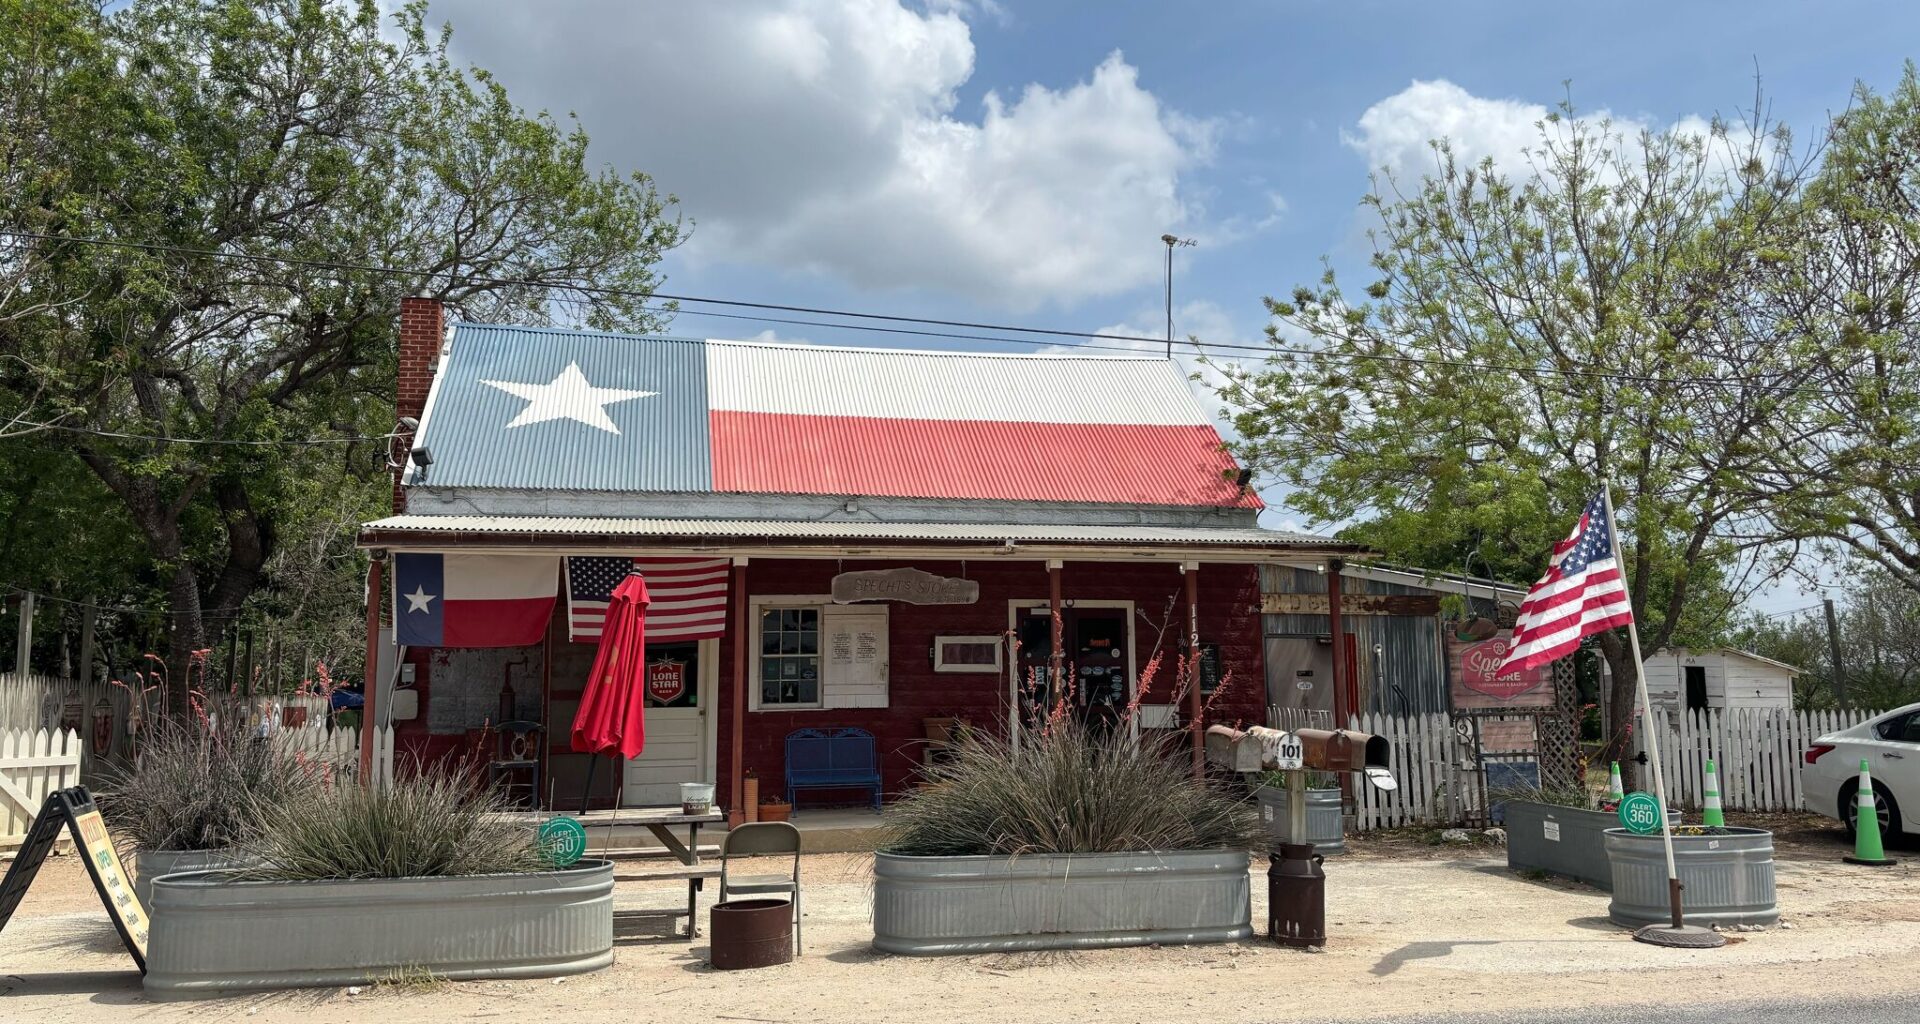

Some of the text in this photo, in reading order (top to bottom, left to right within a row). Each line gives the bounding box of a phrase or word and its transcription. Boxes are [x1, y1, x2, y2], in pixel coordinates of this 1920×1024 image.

[1190, 603, 1200, 647] 112
[652, 672, 679, 681] LONE
[652, 680, 679, 689] STAR
[1281, 744, 1301, 759] 101
[1631, 802, 1653, 811] ALERT
[1630, 809, 1653, 825] 360
[549, 829, 573, 838] LERT
